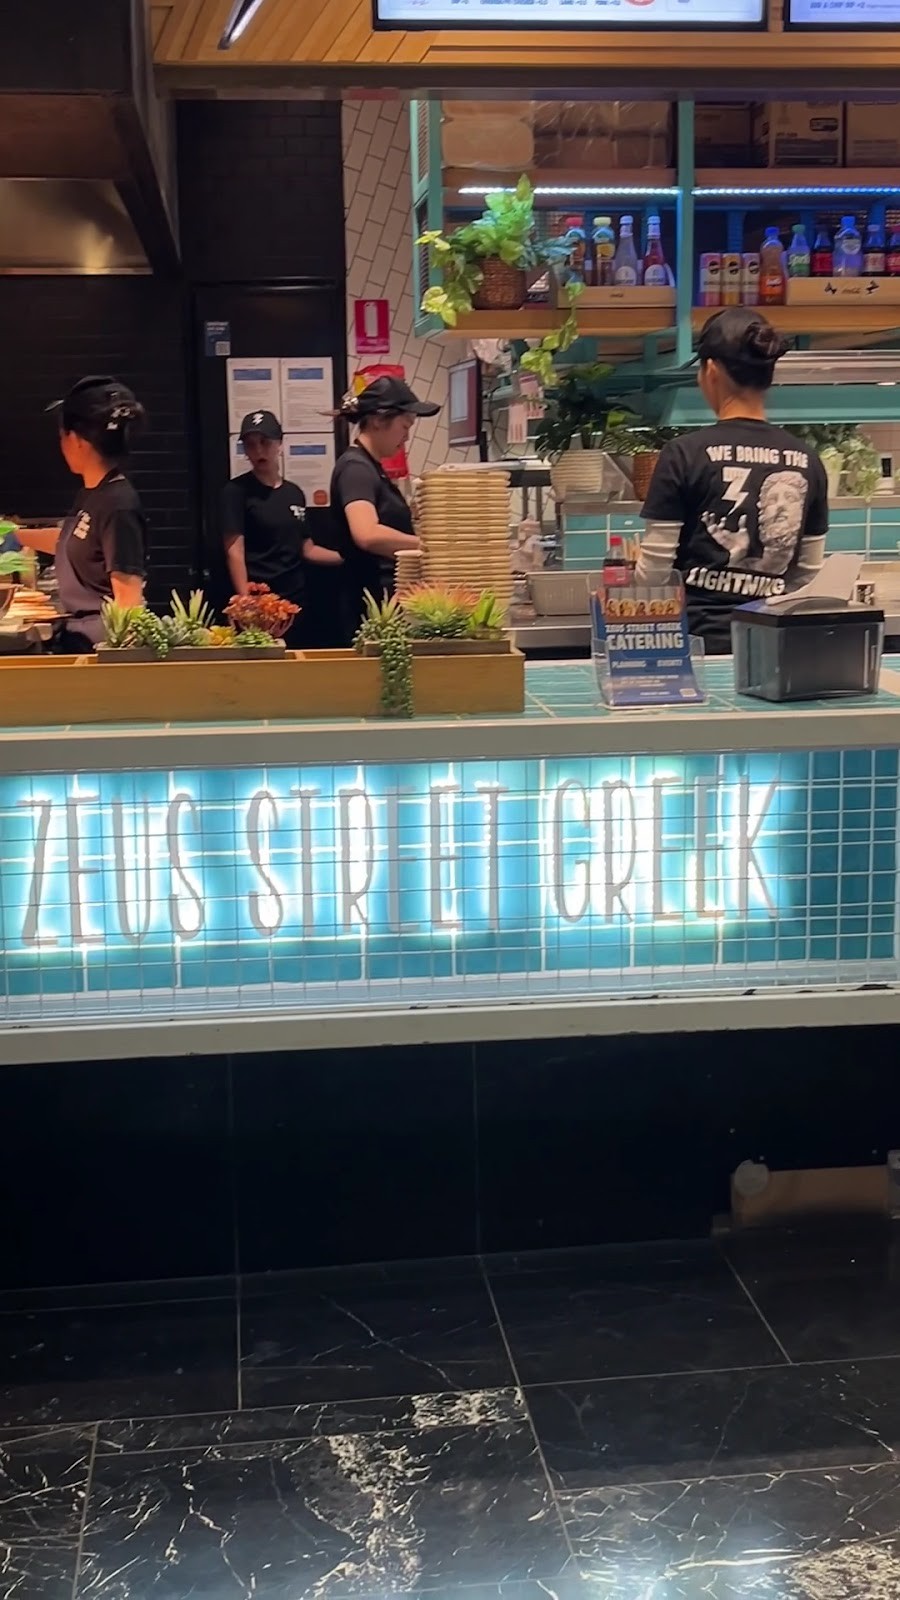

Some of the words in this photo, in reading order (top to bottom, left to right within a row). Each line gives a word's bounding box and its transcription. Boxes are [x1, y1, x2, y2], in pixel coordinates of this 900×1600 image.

[706, 445, 732, 462] WE
[736, 445, 780, 465] BRING
[783, 450, 809, 469] THE
[685, 567, 786, 597] LIGHTNING
[606, 633, 684, 650] CATERING
[16, 792, 205, 946] ZEUS
[246, 785, 508, 937] STREET
[553, 775, 780, 923] GREEK
